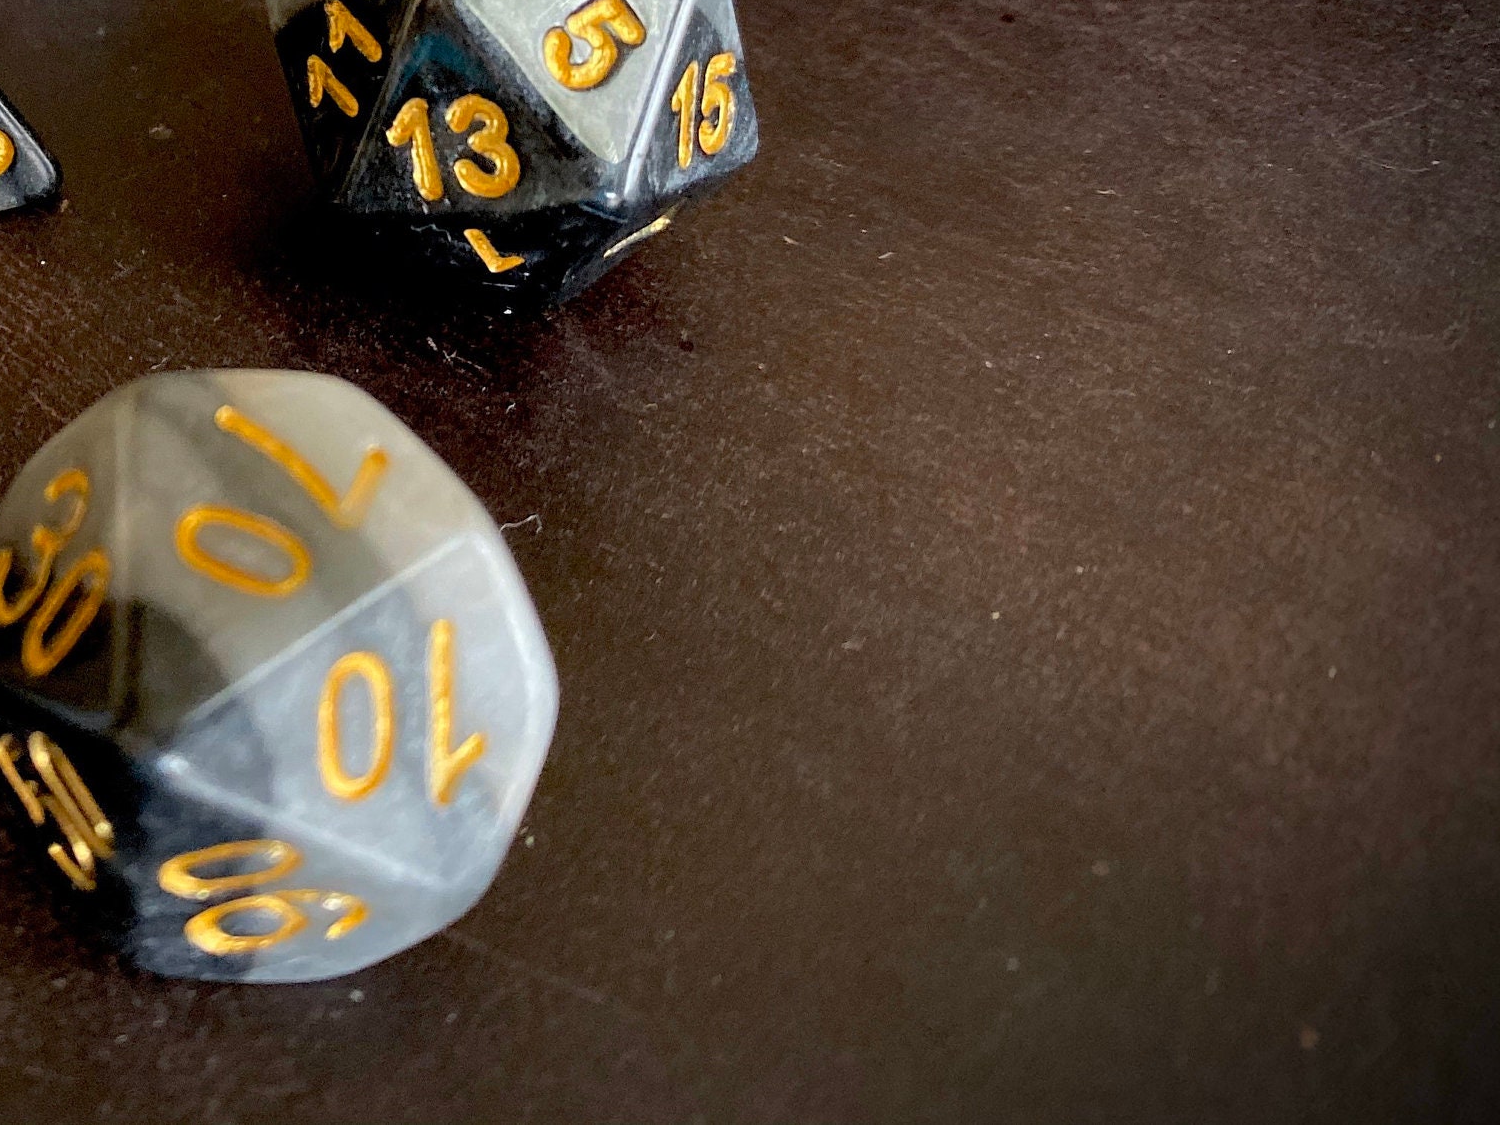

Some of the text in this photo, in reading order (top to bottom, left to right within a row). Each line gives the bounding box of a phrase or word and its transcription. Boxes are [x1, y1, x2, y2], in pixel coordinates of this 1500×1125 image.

[306, 0, 383, 118] 11
[671, 51, 737, 170] 15
[385, 93, 522, 202] 13
[174, 403, 391, 599] 70
[316, 617, 487, 808] 10
